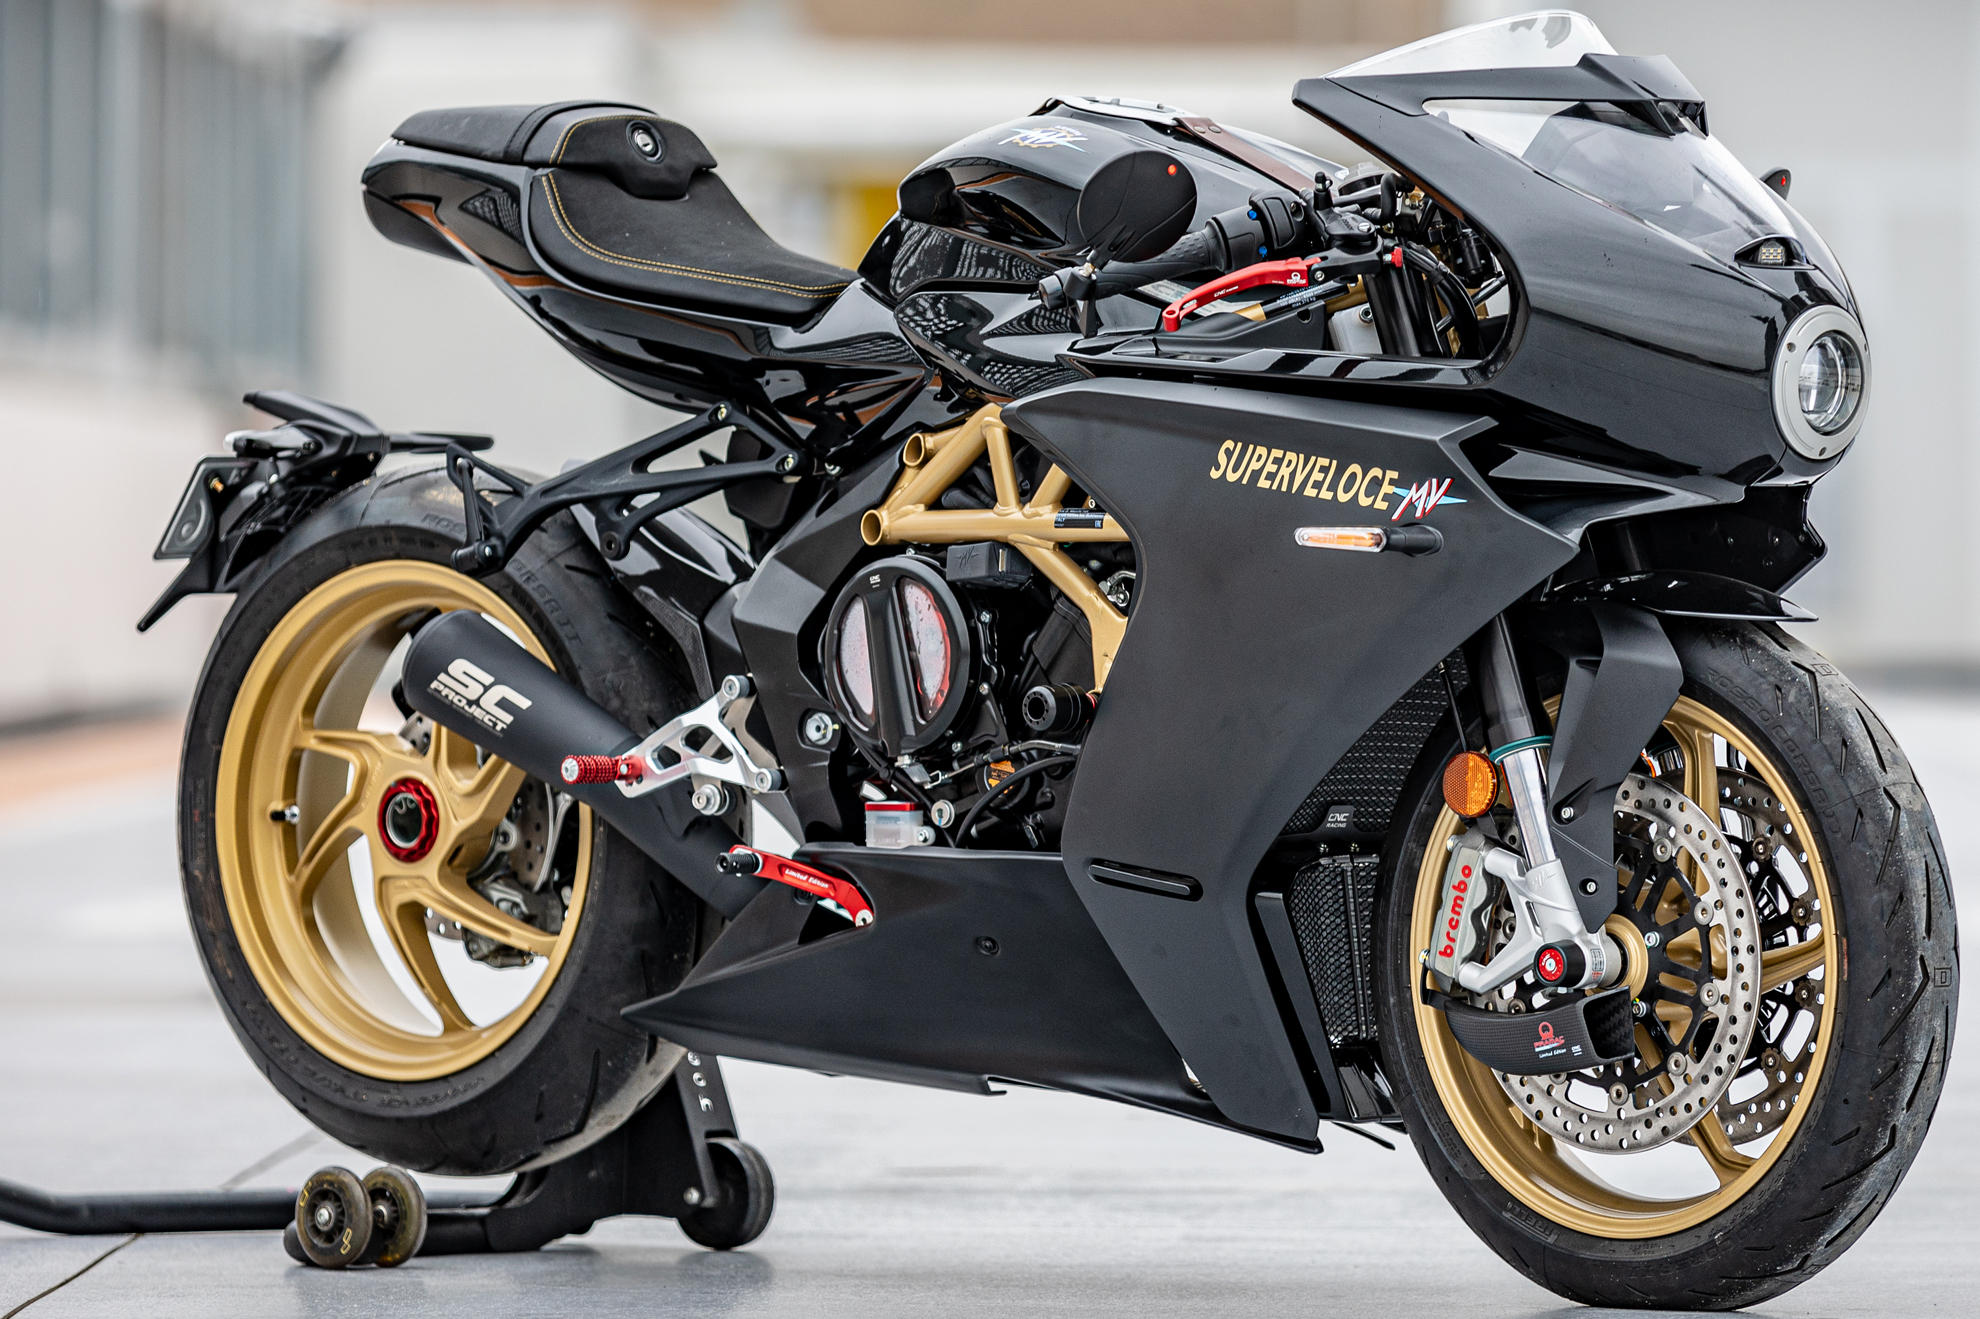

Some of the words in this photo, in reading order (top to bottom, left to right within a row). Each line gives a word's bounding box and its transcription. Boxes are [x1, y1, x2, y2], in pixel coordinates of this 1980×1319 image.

[1209, 439, 1399, 511] SUPERVELOCE
[1391, 478, 1455, 521] MV
[429, 679, 508, 732] PROJECT
[437, 658, 533, 725] SC
[1327, 812, 1350, 822] CNC
[784, 868, 809, 881] Limited
[807, 876, 829, 889] Edition
[1438, 864, 1473, 959] brembo
